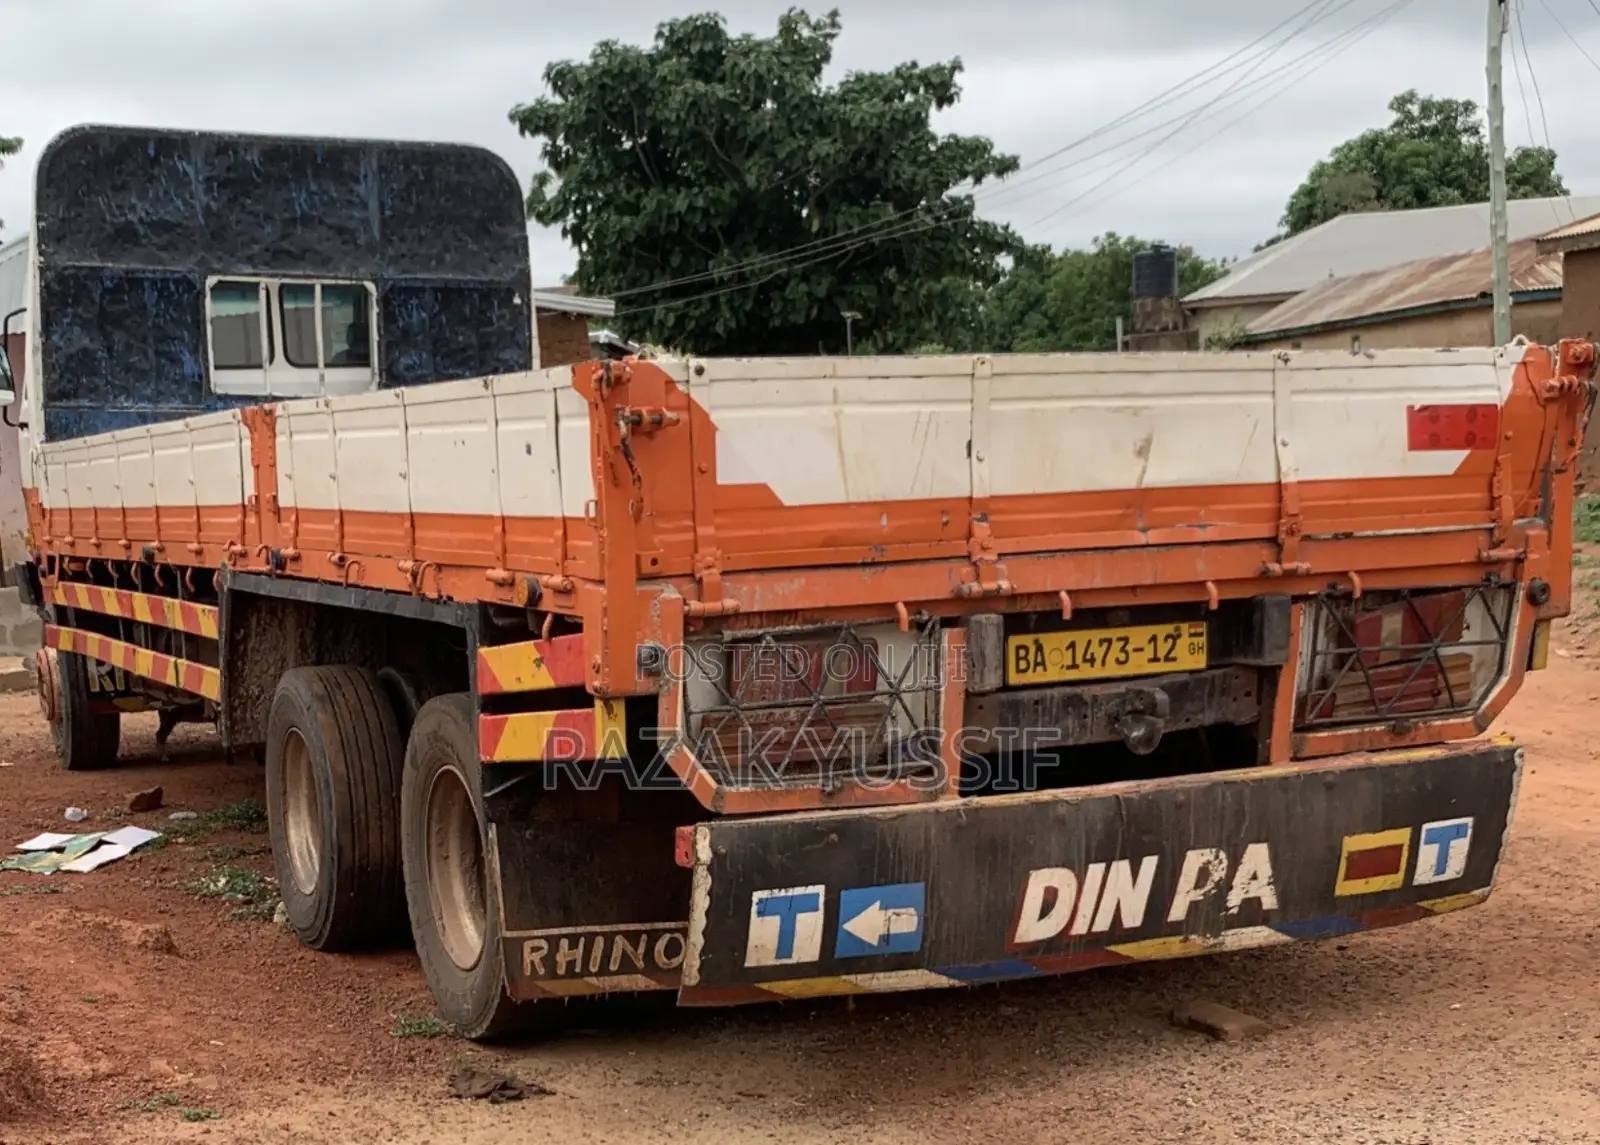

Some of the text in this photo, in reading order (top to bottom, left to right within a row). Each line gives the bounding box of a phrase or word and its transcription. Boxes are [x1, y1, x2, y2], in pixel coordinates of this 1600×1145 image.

[1014, 633, 1179, 674] BA 1473-12
[1188, 642, 1205, 656] GH
[1423, 822, 1471, 877] T
[1012, 842, 1280, 944] DIN PA
[756, 892, 822, 960] T
[522, 932, 686, 976] RHINO
